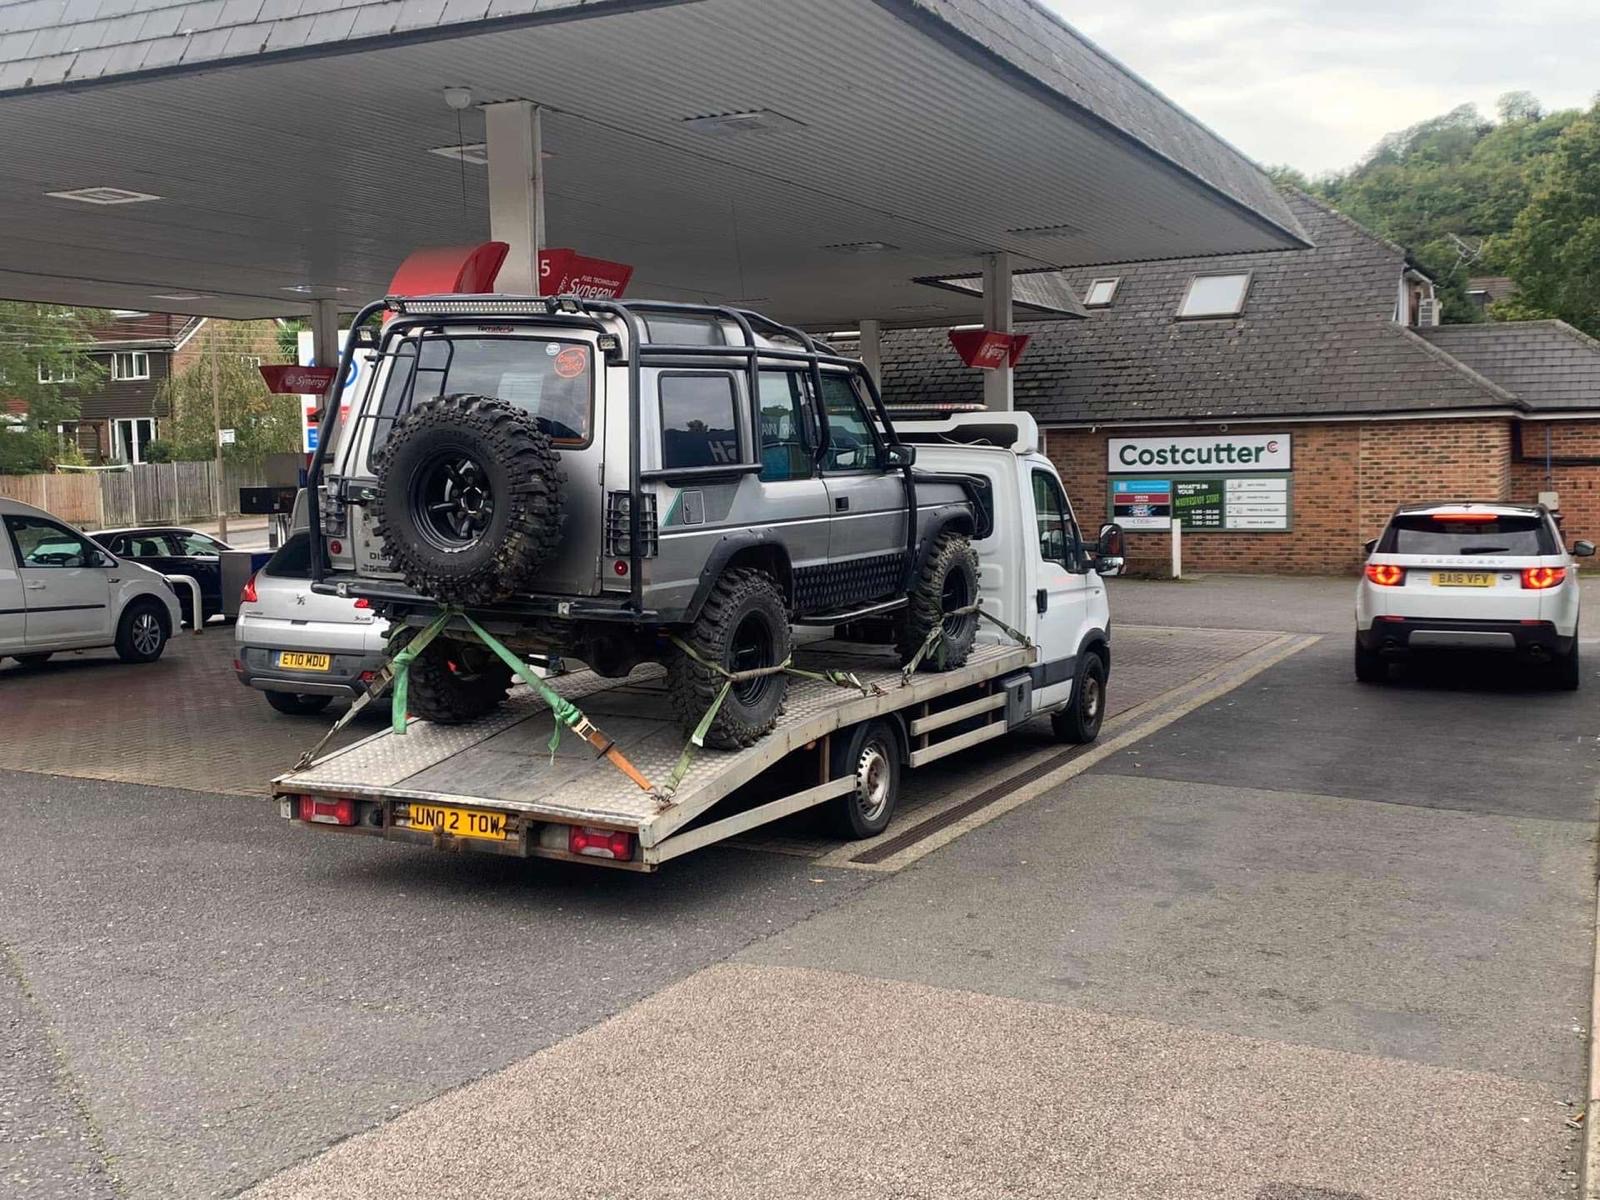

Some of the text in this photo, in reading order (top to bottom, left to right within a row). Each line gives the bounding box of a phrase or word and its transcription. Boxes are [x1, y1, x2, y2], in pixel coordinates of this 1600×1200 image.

[540, 259, 551, 277] 5
[296, 375, 328, 388] Synergy
[1119, 442, 1265, 466] Costcutter
[282, 653, 304, 666] ET10
[467, 813, 500, 836] TOW
